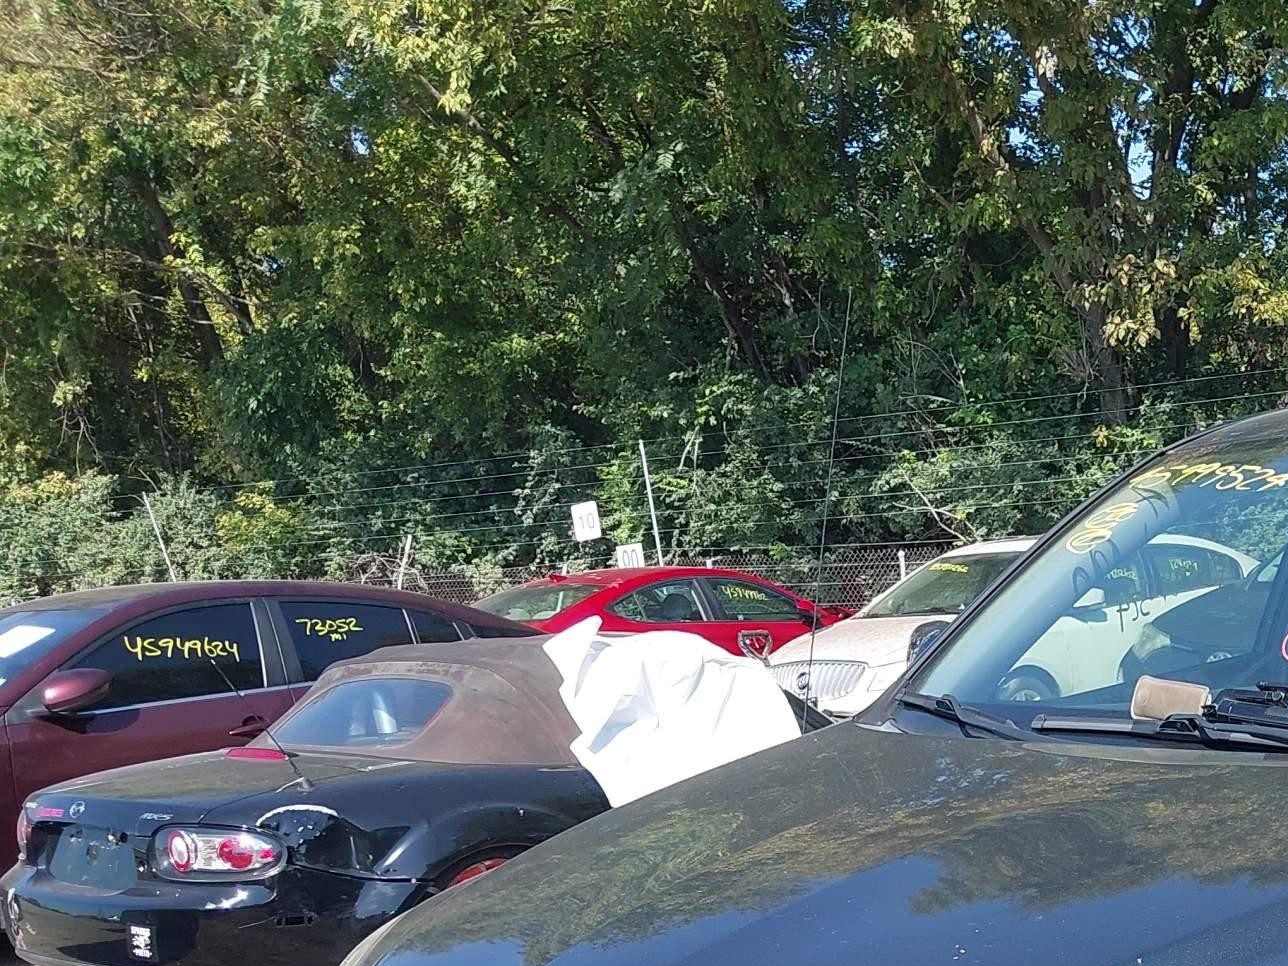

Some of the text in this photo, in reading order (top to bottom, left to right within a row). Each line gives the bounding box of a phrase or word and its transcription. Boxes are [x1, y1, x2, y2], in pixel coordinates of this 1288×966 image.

[578, 512, 595, 530] 10
[295, 617, 365, 636] 73052
[123, 635, 241, 664] 45949624
